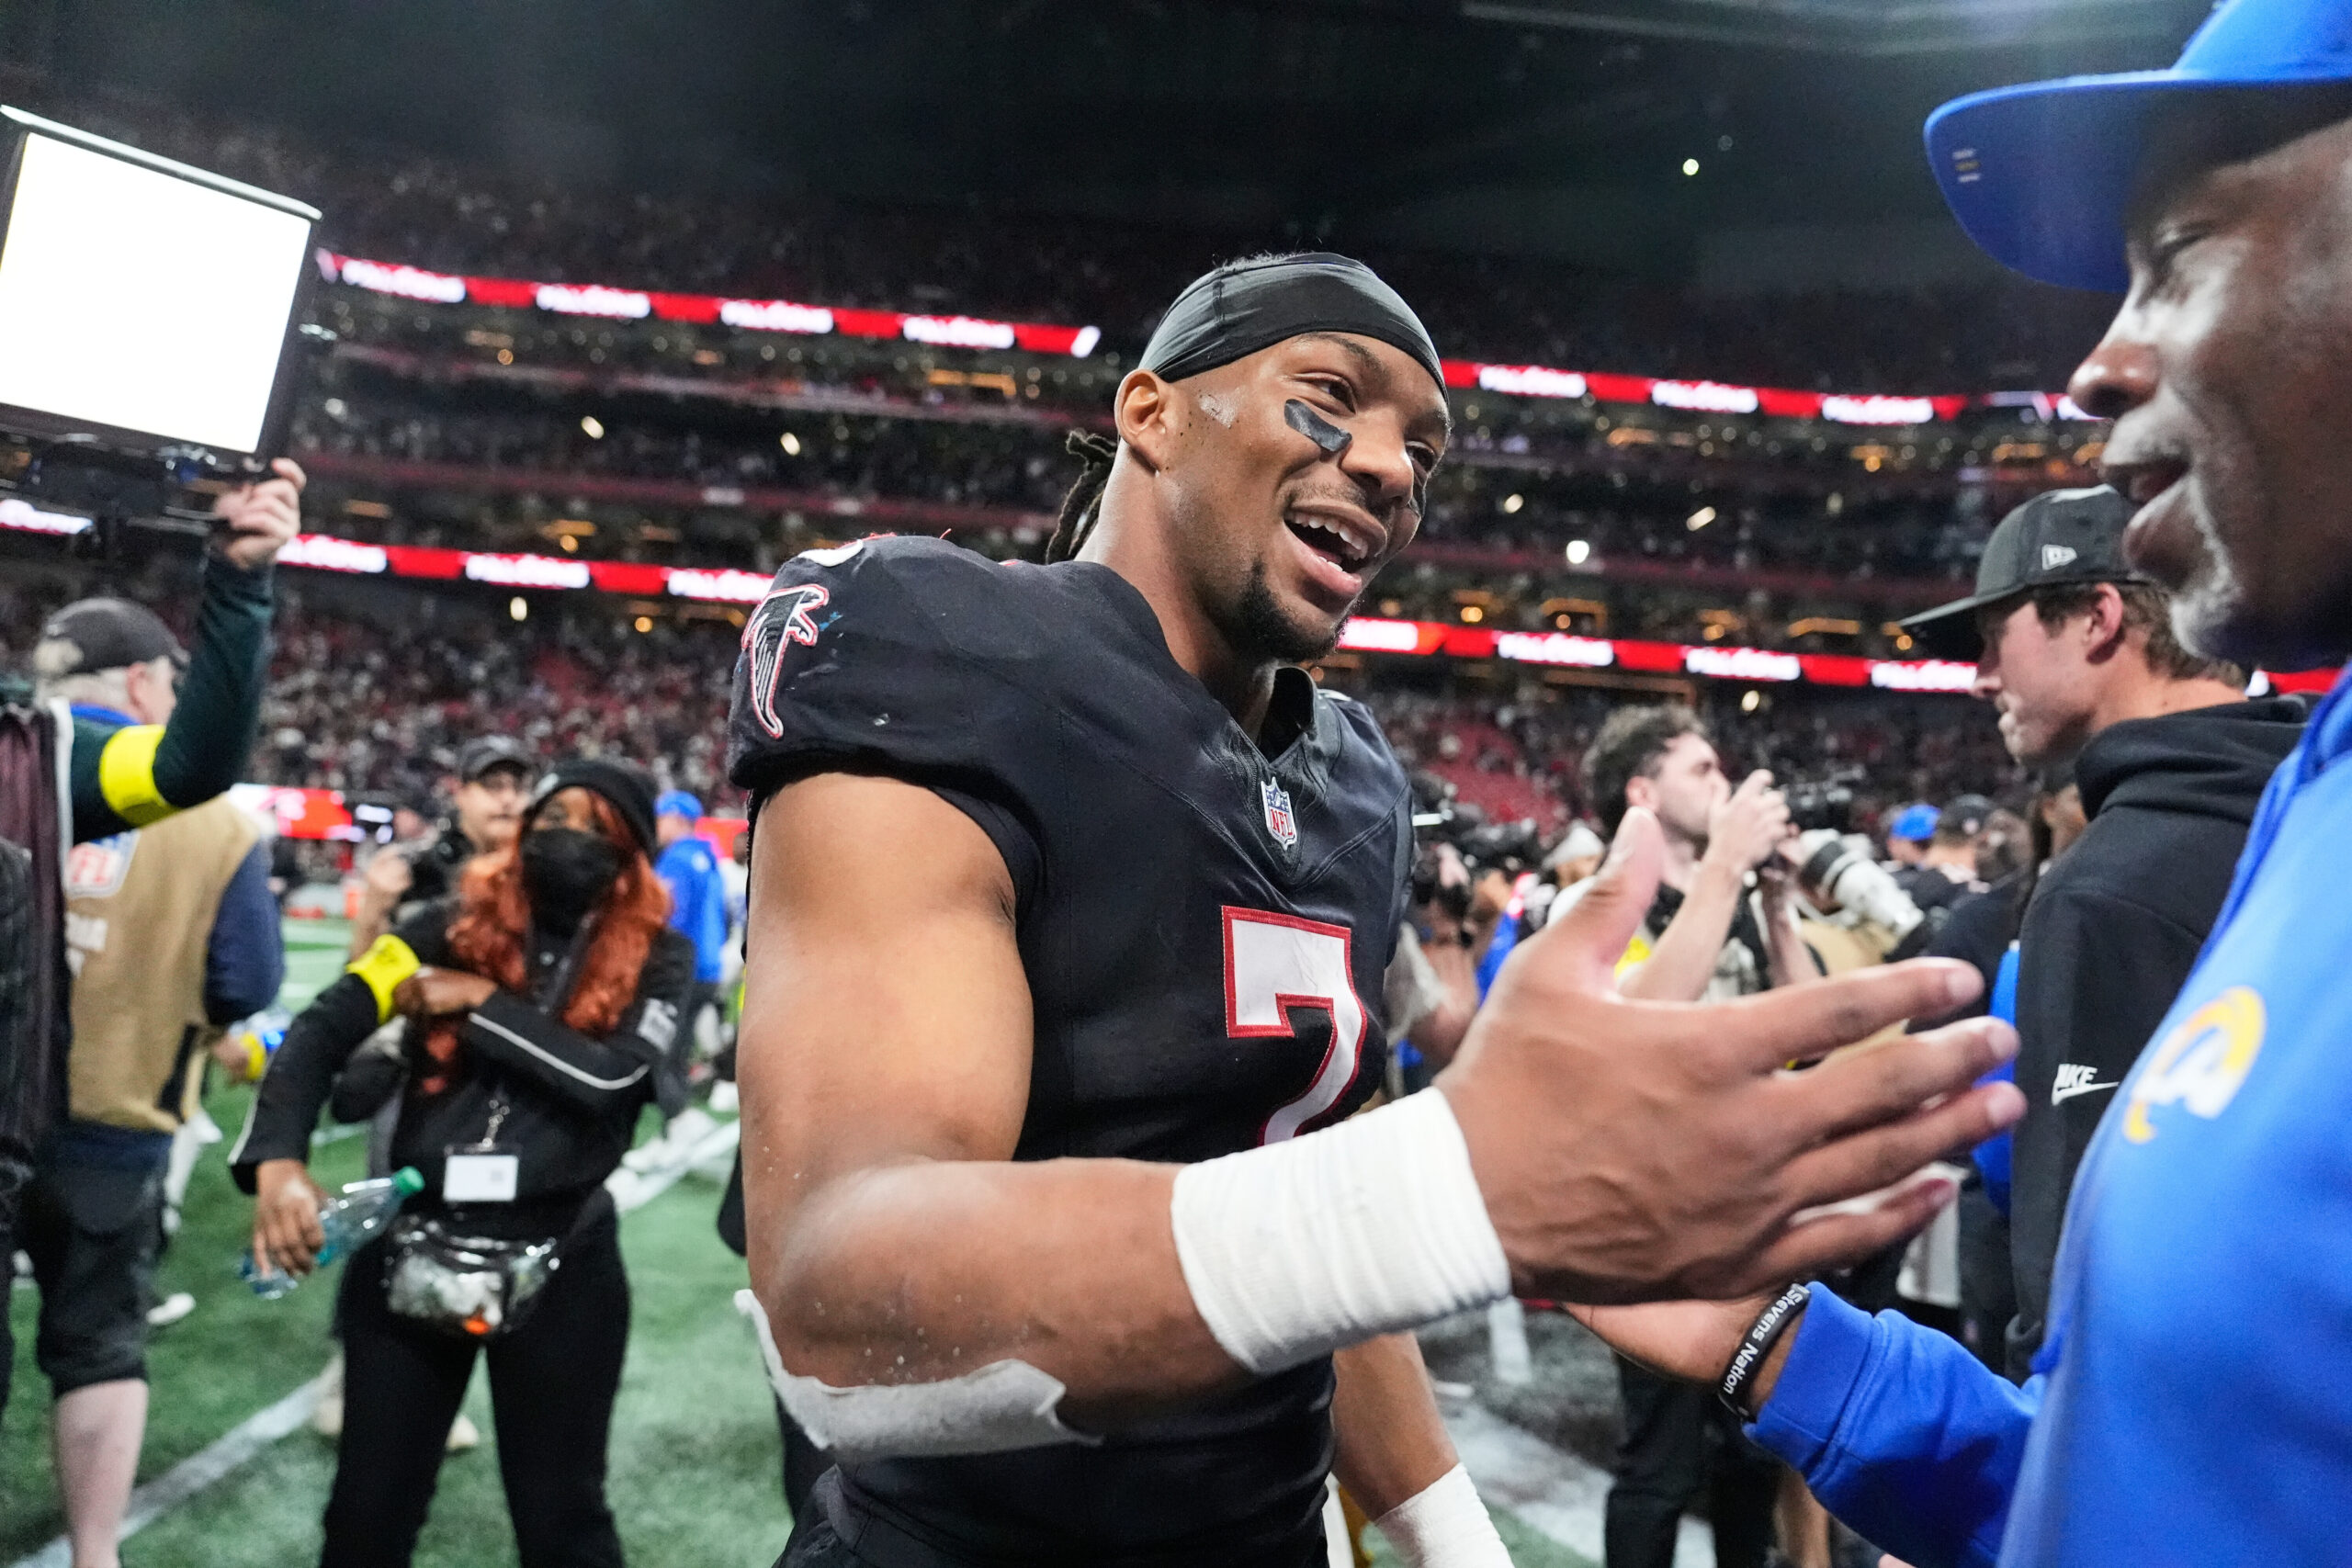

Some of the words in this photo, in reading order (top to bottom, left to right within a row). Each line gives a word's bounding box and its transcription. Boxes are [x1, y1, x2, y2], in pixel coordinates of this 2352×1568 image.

[1270, 808, 1294, 837] NFL
[1222, 906, 1368, 1147] 7
[2056, 1063, 2098, 1088] NIKE
[1752, 1289, 1804, 1342] Stevens
[1723, 1342, 1759, 1394] Nation
